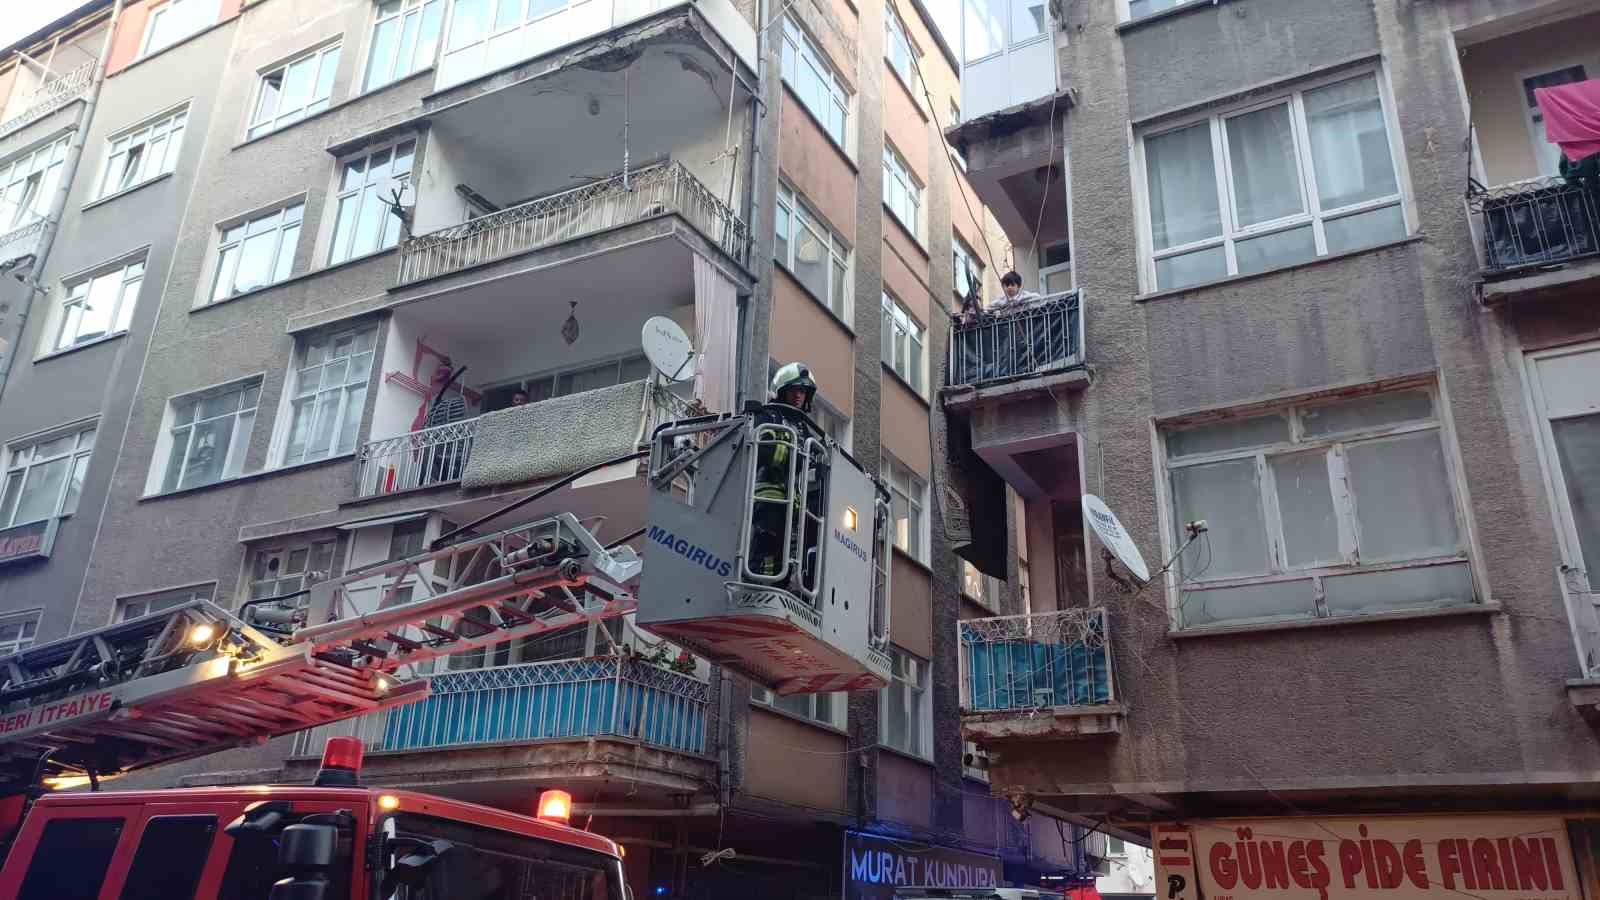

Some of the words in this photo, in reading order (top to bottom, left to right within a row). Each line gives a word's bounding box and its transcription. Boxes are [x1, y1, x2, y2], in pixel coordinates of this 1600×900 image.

[648, 525, 732, 577] MAGIRUS
[834, 527, 868, 563] MAGIRUS
[39, 692, 112, 724] İTFAİYE
[851, 847, 919, 887] MURAT
[1209, 826, 1331, 900] GÜNEŞ
[1339, 823, 1430, 890] PİDE
[1438, 837, 1565, 892] FIRINI
